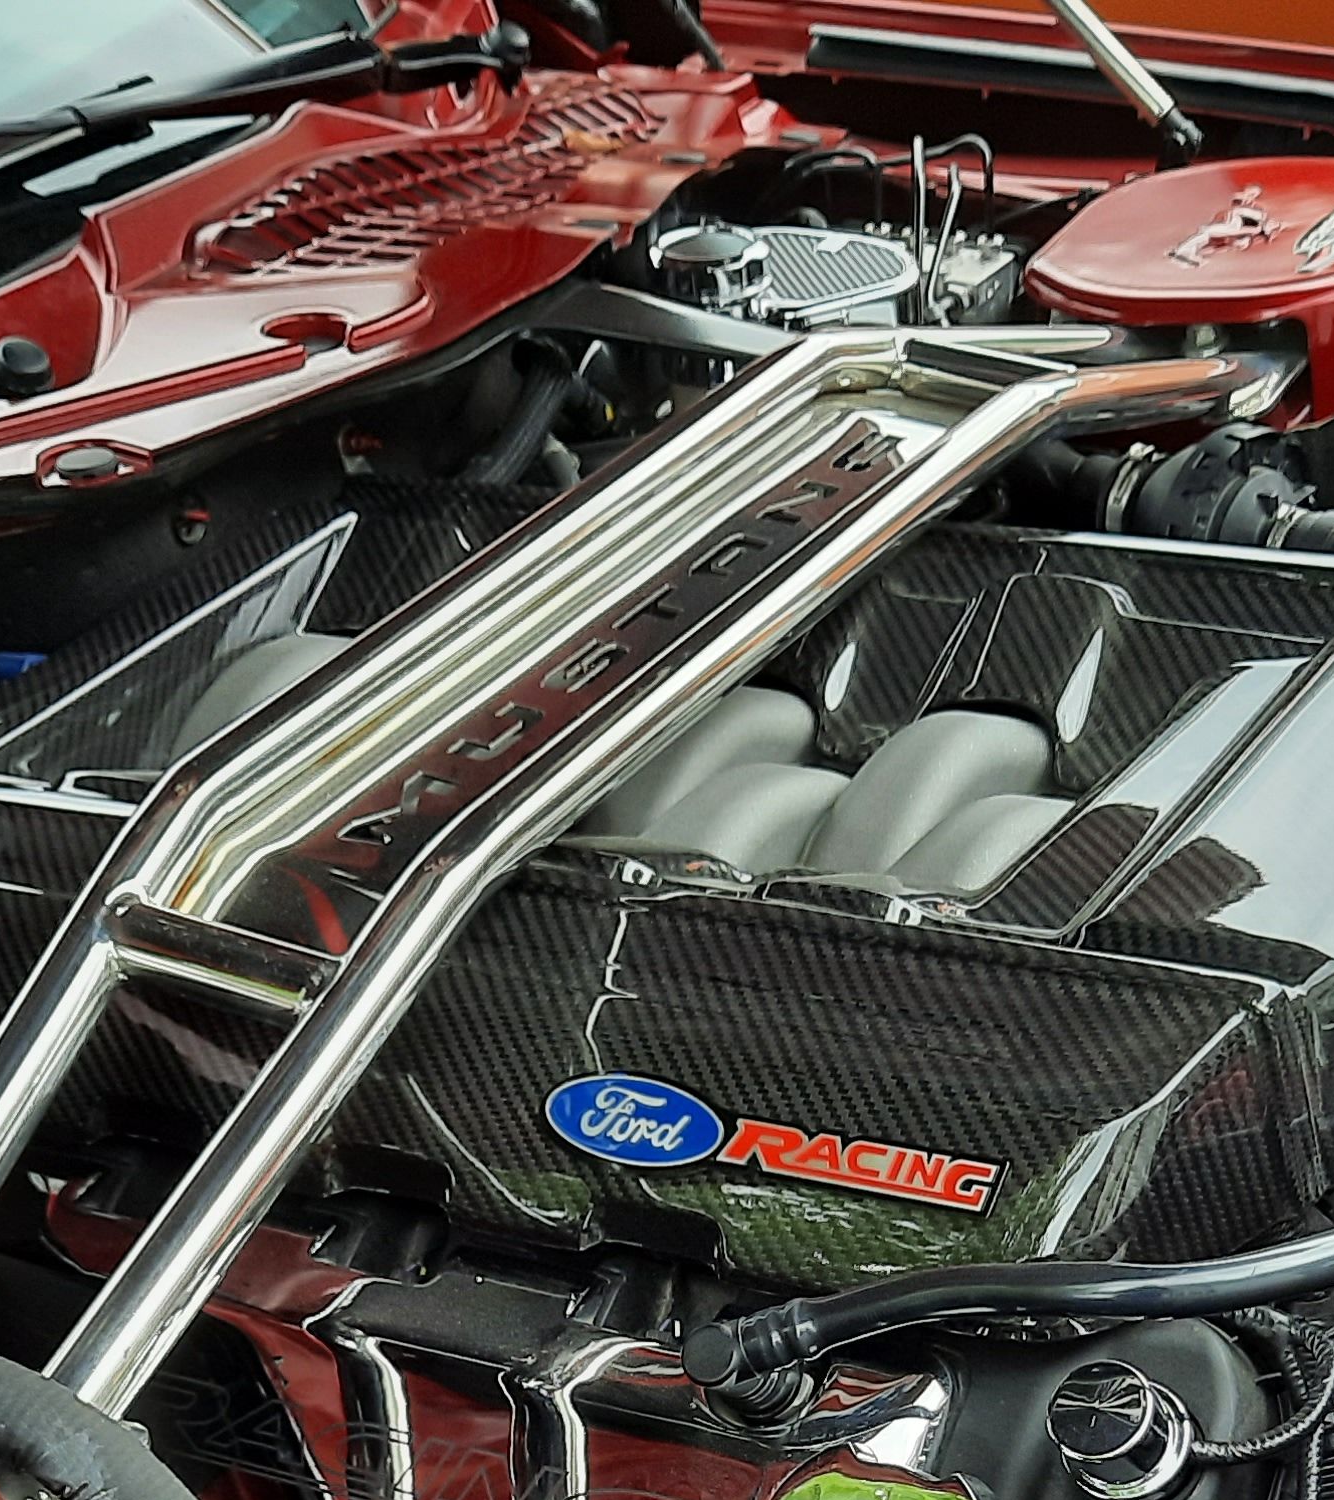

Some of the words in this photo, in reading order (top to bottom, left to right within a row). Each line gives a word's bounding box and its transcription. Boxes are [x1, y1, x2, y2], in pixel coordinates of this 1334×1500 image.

[336, 418, 904, 847] MUSTANG
[581, 1084, 692, 1153] Ford
[717, 1118, 999, 1212] RACING
